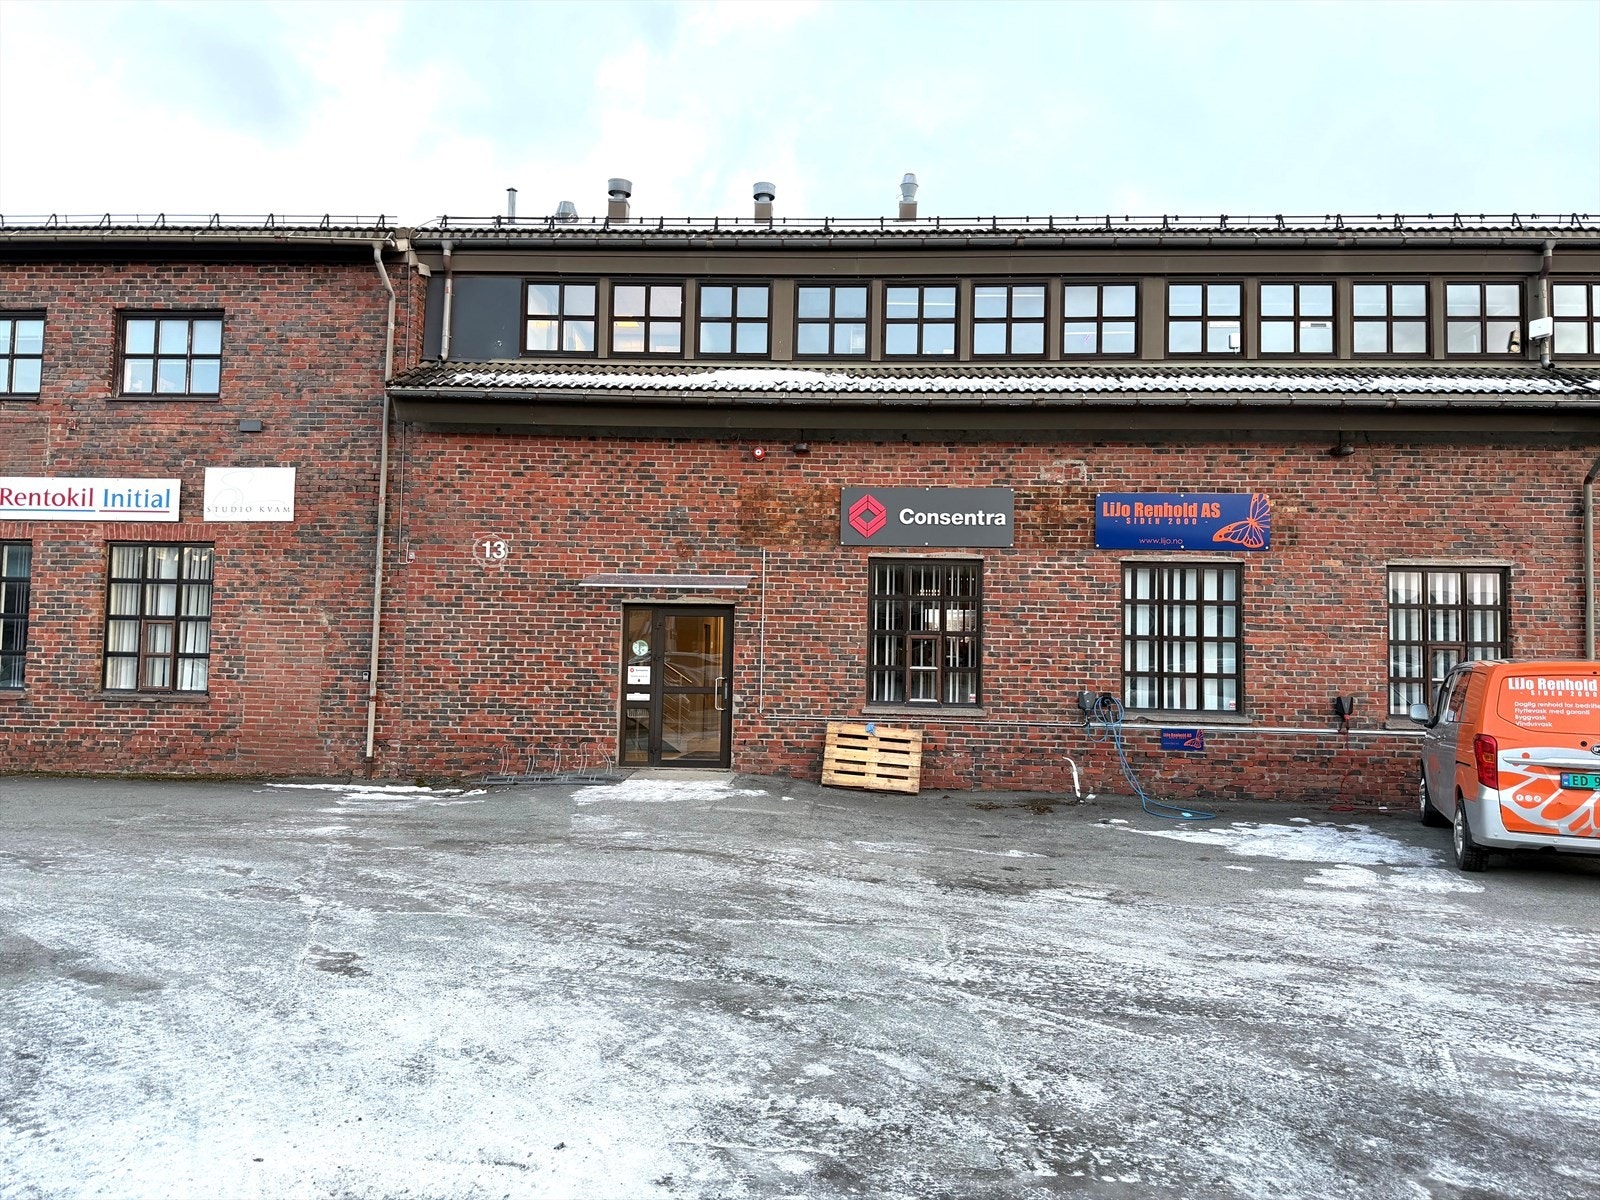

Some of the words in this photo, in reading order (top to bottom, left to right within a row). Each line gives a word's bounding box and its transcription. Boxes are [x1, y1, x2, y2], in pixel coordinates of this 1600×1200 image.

[0, 487, 94, 507] Rentokil
[103, 488, 171, 508] Initial
[1102, 501, 1131, 517] LiJo
[1134, 502, 1198, 518] Renhold
[1201, 503, 1221, 518] AS
[899, 508, 1007, 526] Consentra
[1126, 517, 1160, 525] SIDEN
[1168, 518, 1198, 526] 2000
[1138, 537, 1184, 546] www.lijo.no
[482, 540, 506, 559] 13
[1537, 678, 1598, 692] Renhold
[1570, 690, 1598, 698] 2000
[1572, 775, 1589, 787] ED
